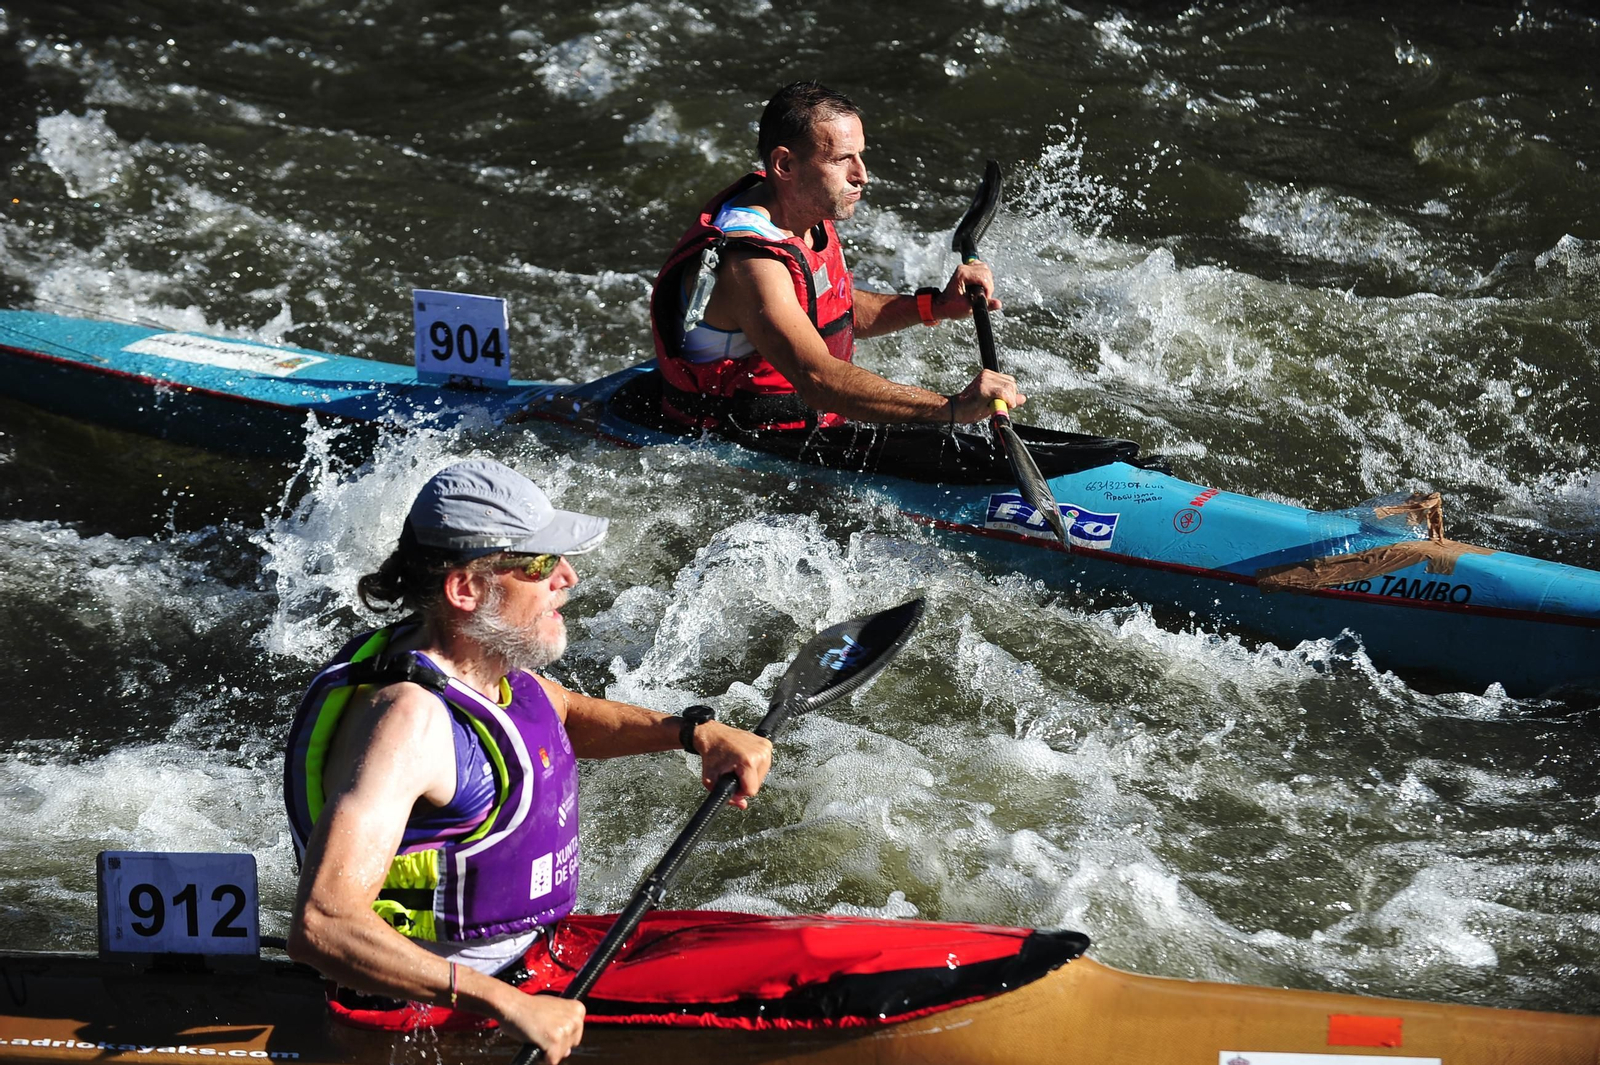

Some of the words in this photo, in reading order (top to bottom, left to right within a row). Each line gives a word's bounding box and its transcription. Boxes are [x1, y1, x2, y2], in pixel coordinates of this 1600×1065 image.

[429, 321, 505, 367] 904
[1378, 575, 1472, 604] TAMBO
[554, 864, 569, 886] DE
[128, 883, 248, 938] 912
